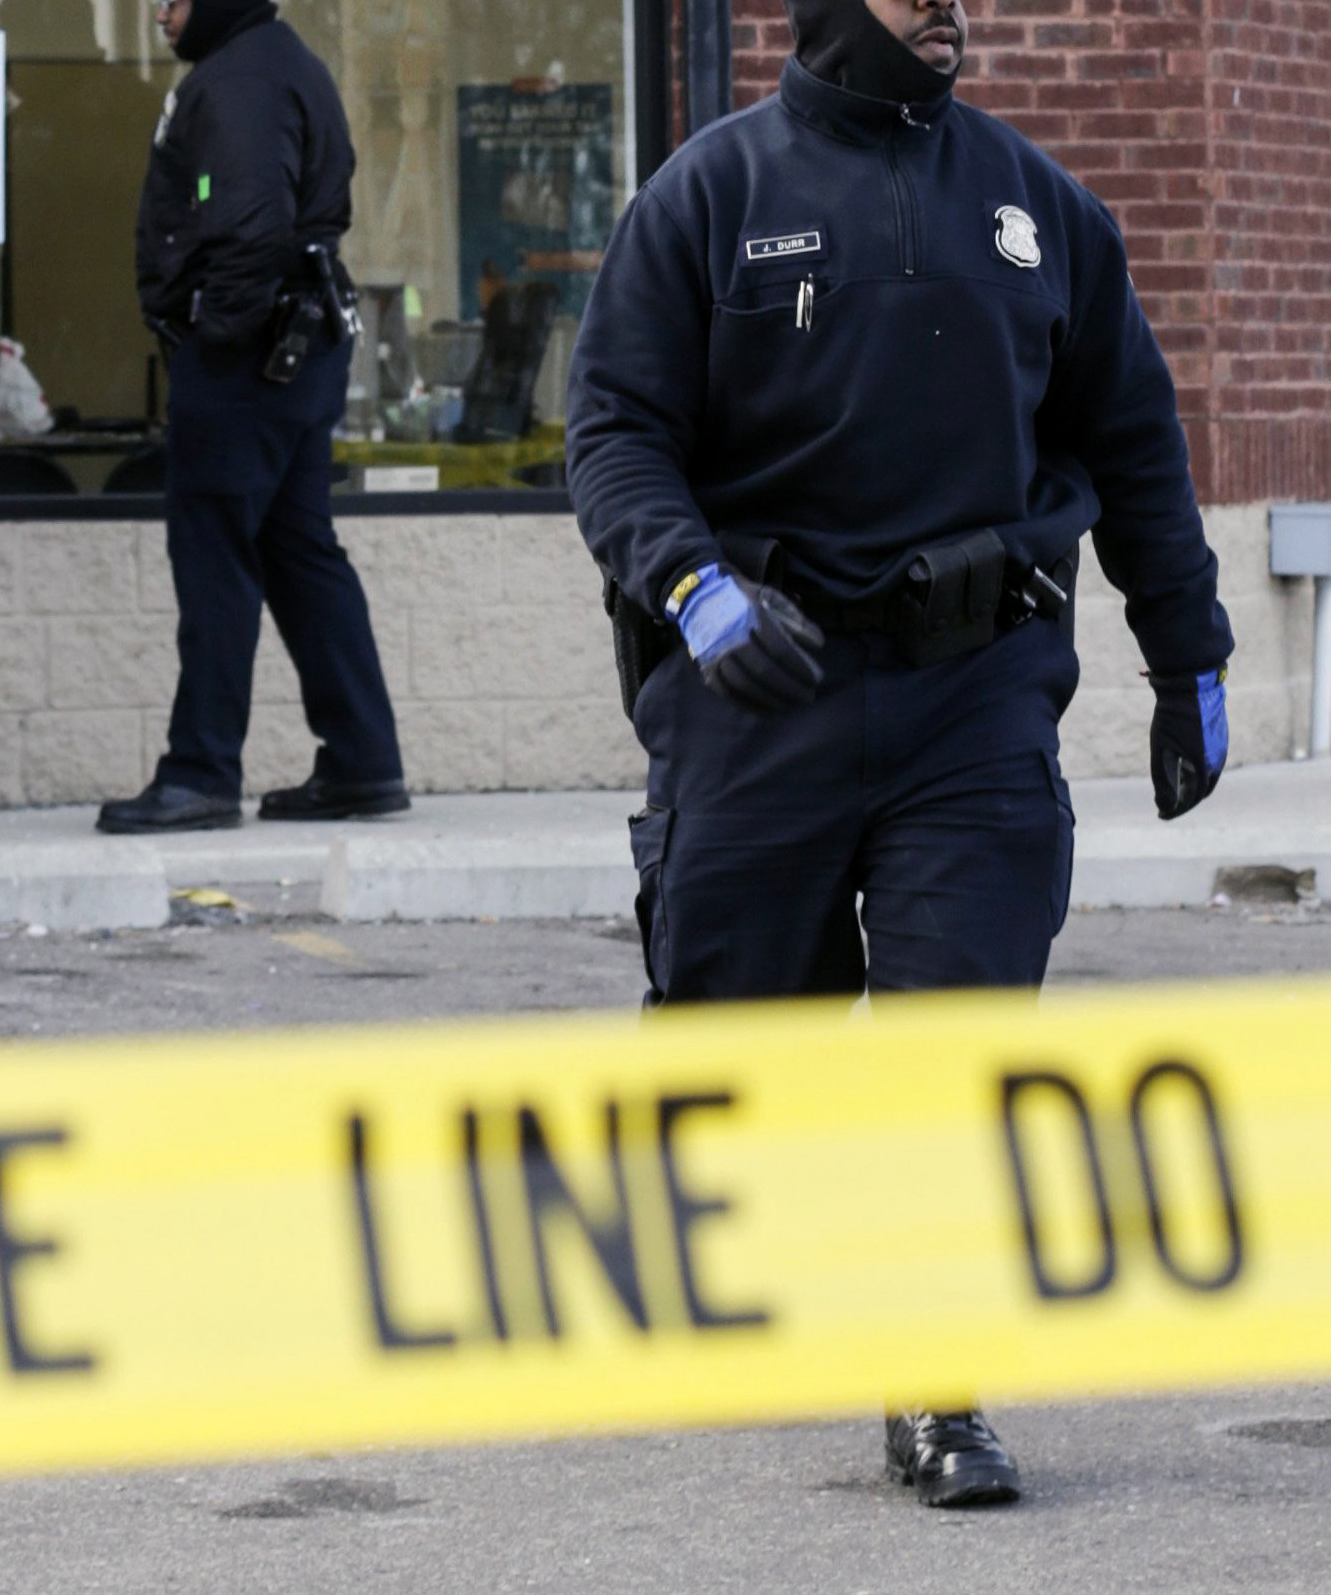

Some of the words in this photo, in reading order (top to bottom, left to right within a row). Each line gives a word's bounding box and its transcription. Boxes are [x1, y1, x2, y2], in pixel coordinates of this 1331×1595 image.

[777, 238, 805, 251] DURR
[345, 1087, 774, 1354] LINE
[997, 1056, 1248, 1304] DO
